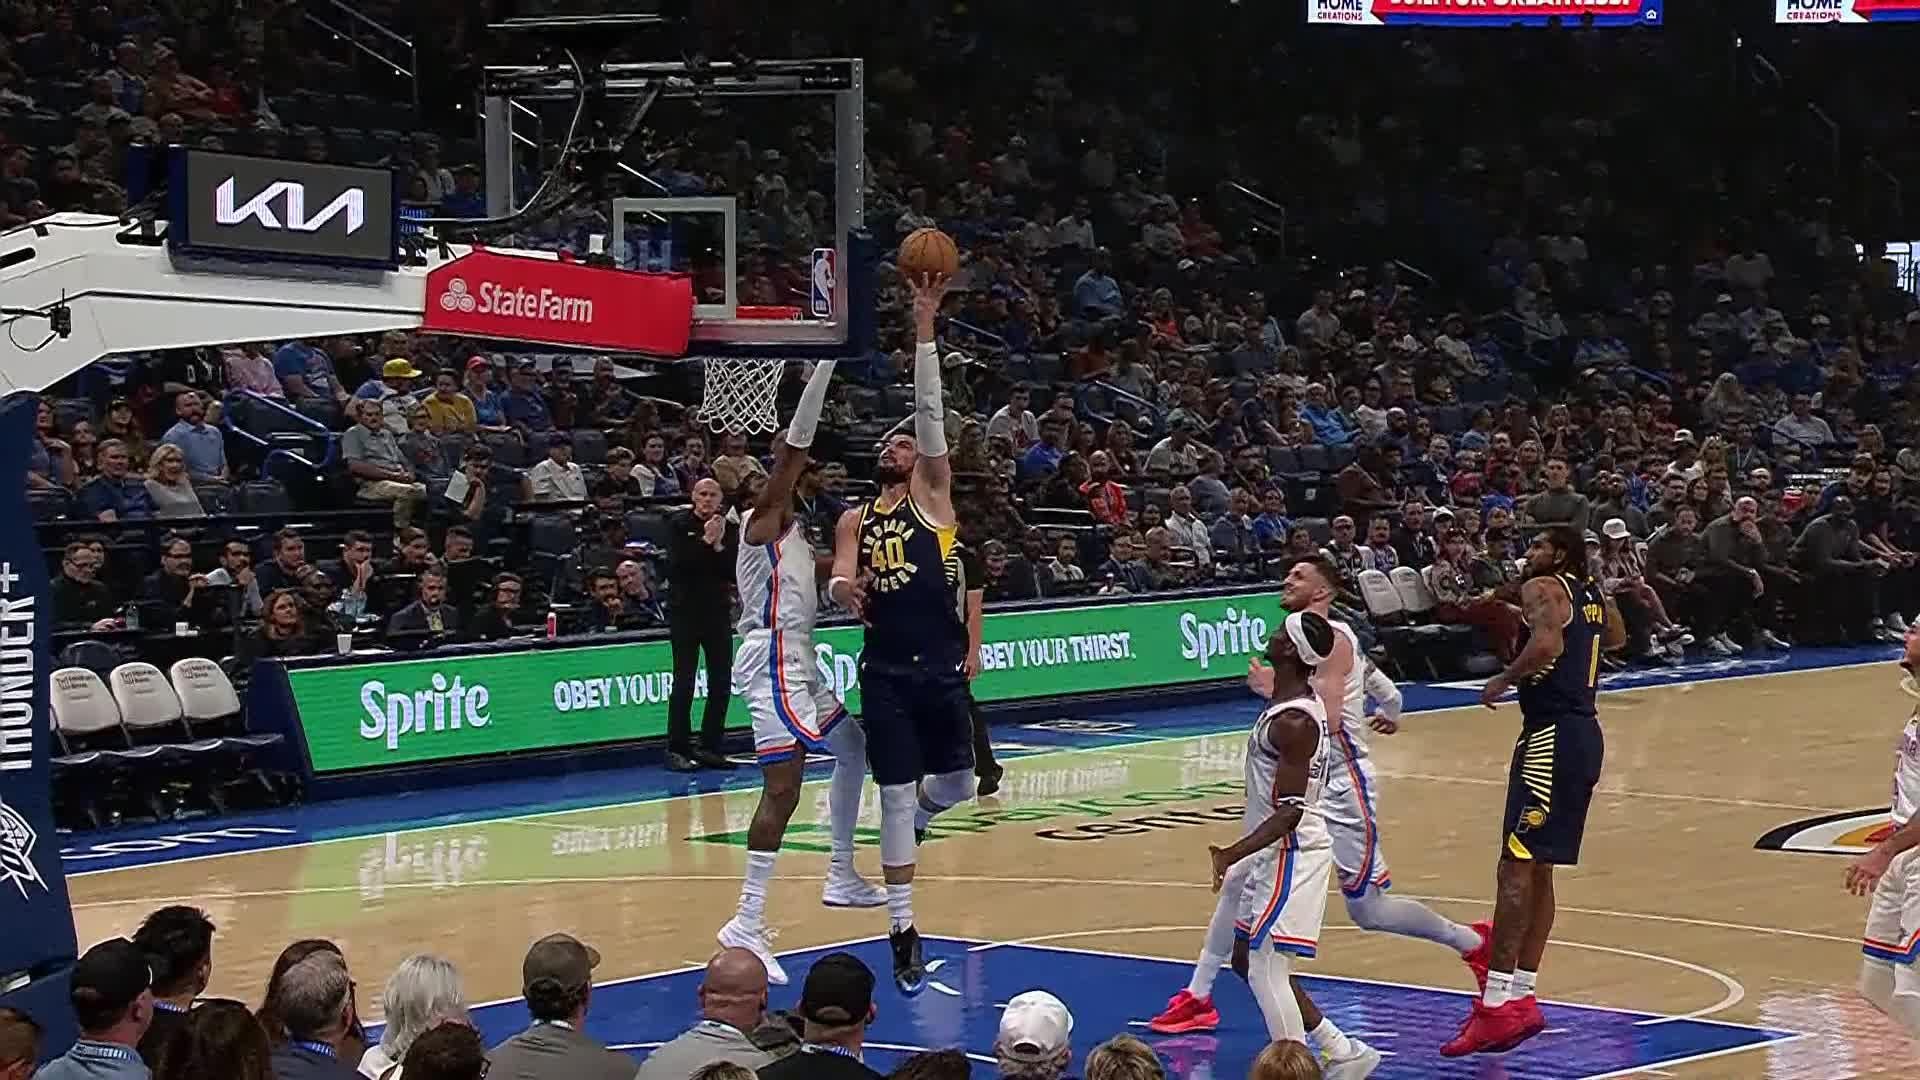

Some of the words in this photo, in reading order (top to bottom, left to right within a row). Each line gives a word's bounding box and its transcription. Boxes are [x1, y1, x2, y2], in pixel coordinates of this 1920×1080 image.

[1317, 12, 1363, 21] CREATIONS
[1786, 11, 1842, 20] CREATIONS
[216, 176, 364, 235] KIA
[862, 518, 915, 554] INDIANA
[871, 536, 905, 573] 40
[872, 562, 918, 593] ACERS
[980, 643, 1015, 672] BEY
[1018, 637, 1068, 668] YOUR
[1180, 607, 1269, 669] Sprite
[554, 679, 612, 712] OBEY
[617, 671, 674, 706] YOUR
[360, 672, 491, 750] Sprite
[1034, 806, 1245, 841] cent
